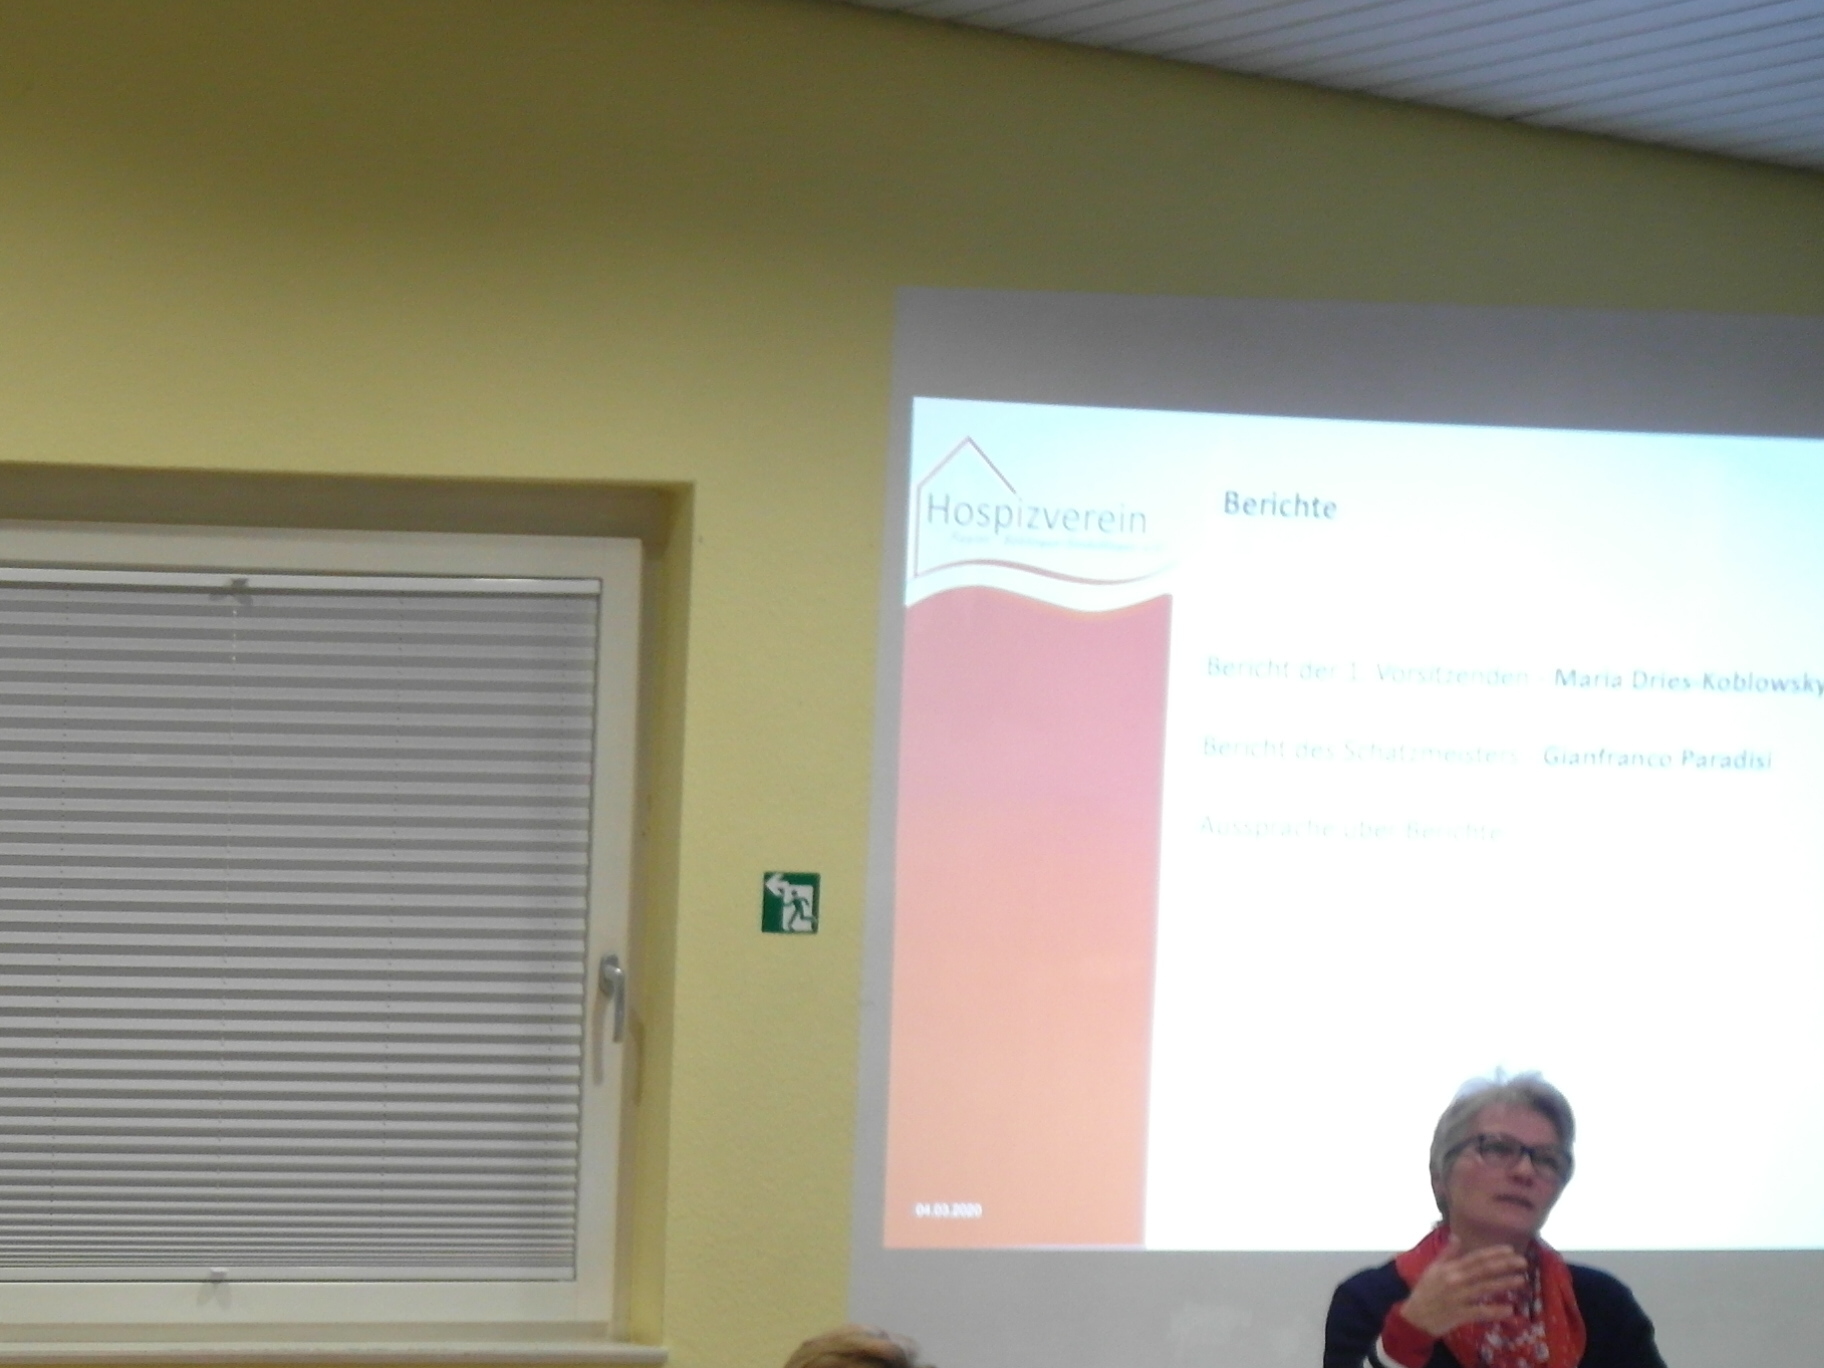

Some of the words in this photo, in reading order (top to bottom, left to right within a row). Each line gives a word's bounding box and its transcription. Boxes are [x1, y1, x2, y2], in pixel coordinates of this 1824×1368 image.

[927, 492, 1147, 534] Hospizverein
[1224, 489, 1337, 520] Berichte
[1554, 668, 1623, 688] Maria
[1680, 748, 1773, 770] Paradisi
